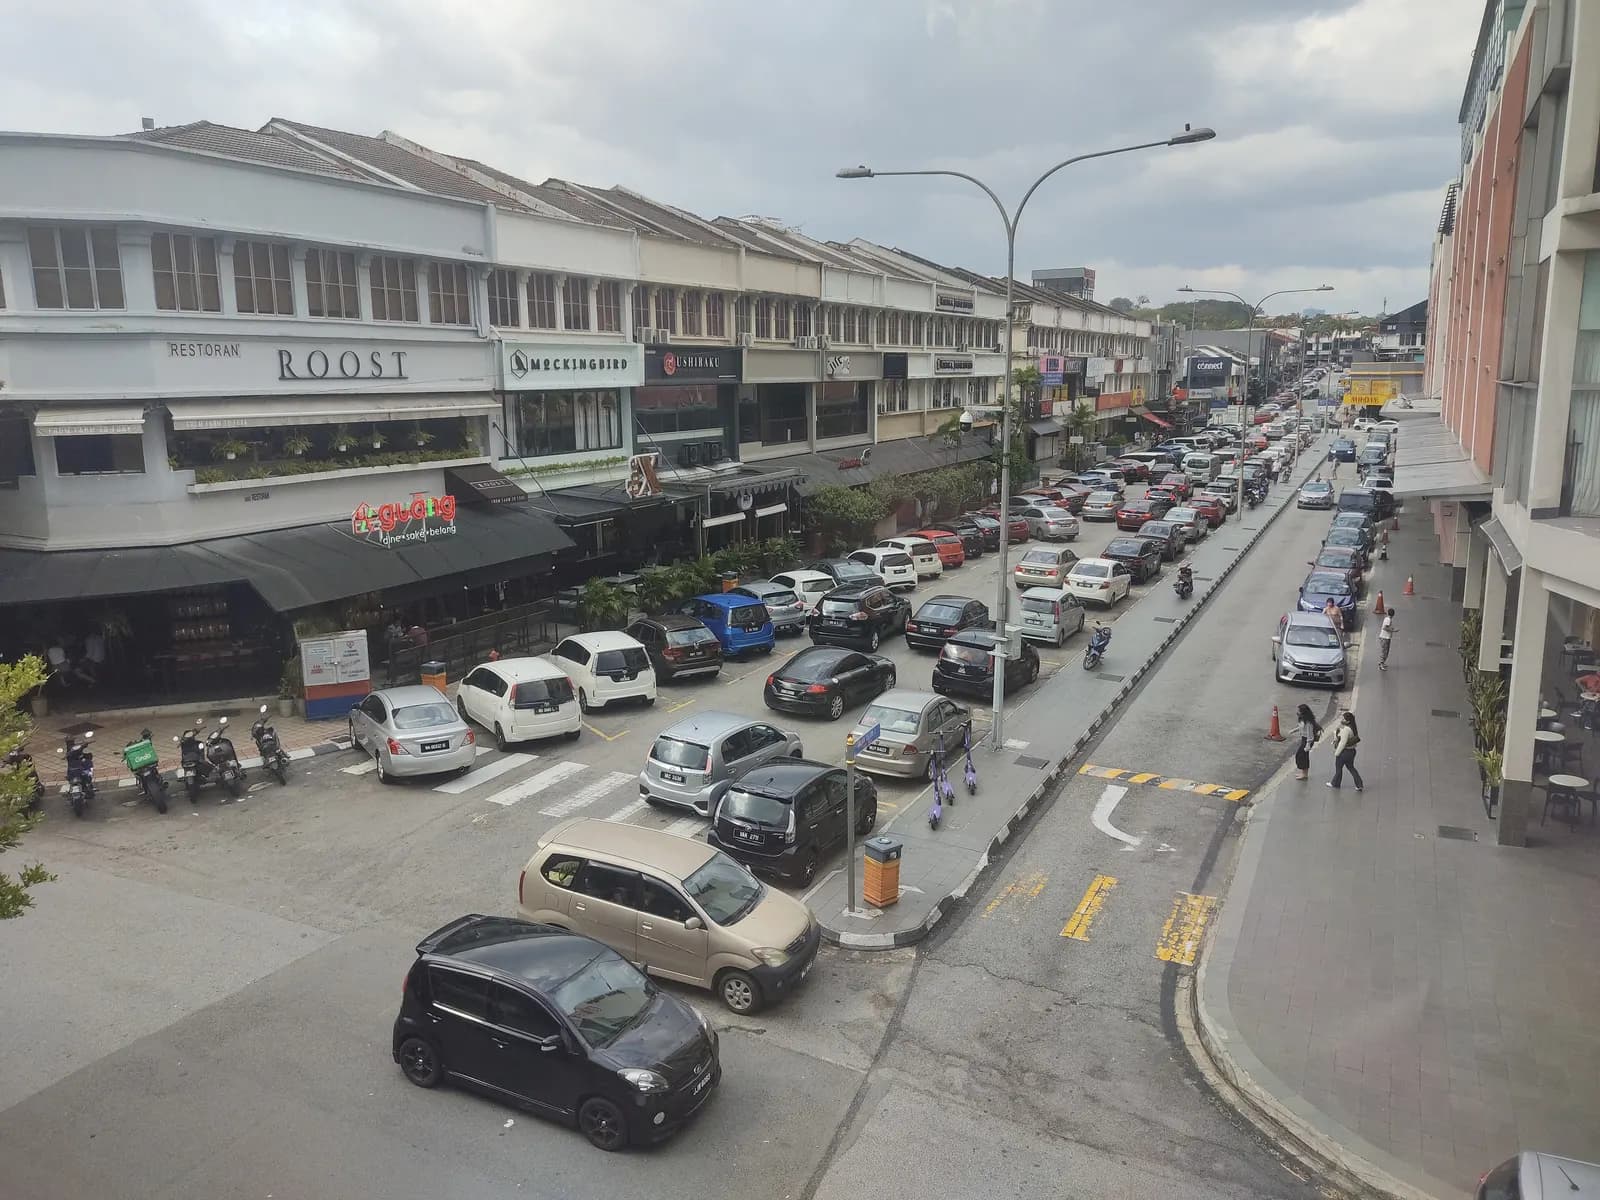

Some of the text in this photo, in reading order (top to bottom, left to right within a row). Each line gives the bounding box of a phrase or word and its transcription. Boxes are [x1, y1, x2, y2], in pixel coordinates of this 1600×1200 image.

[170, 343, 239, 357] RESTORAN
[278, 349, 407, 379] ROOST
[530, 358, 628, 371] MOCKINGBIRD
